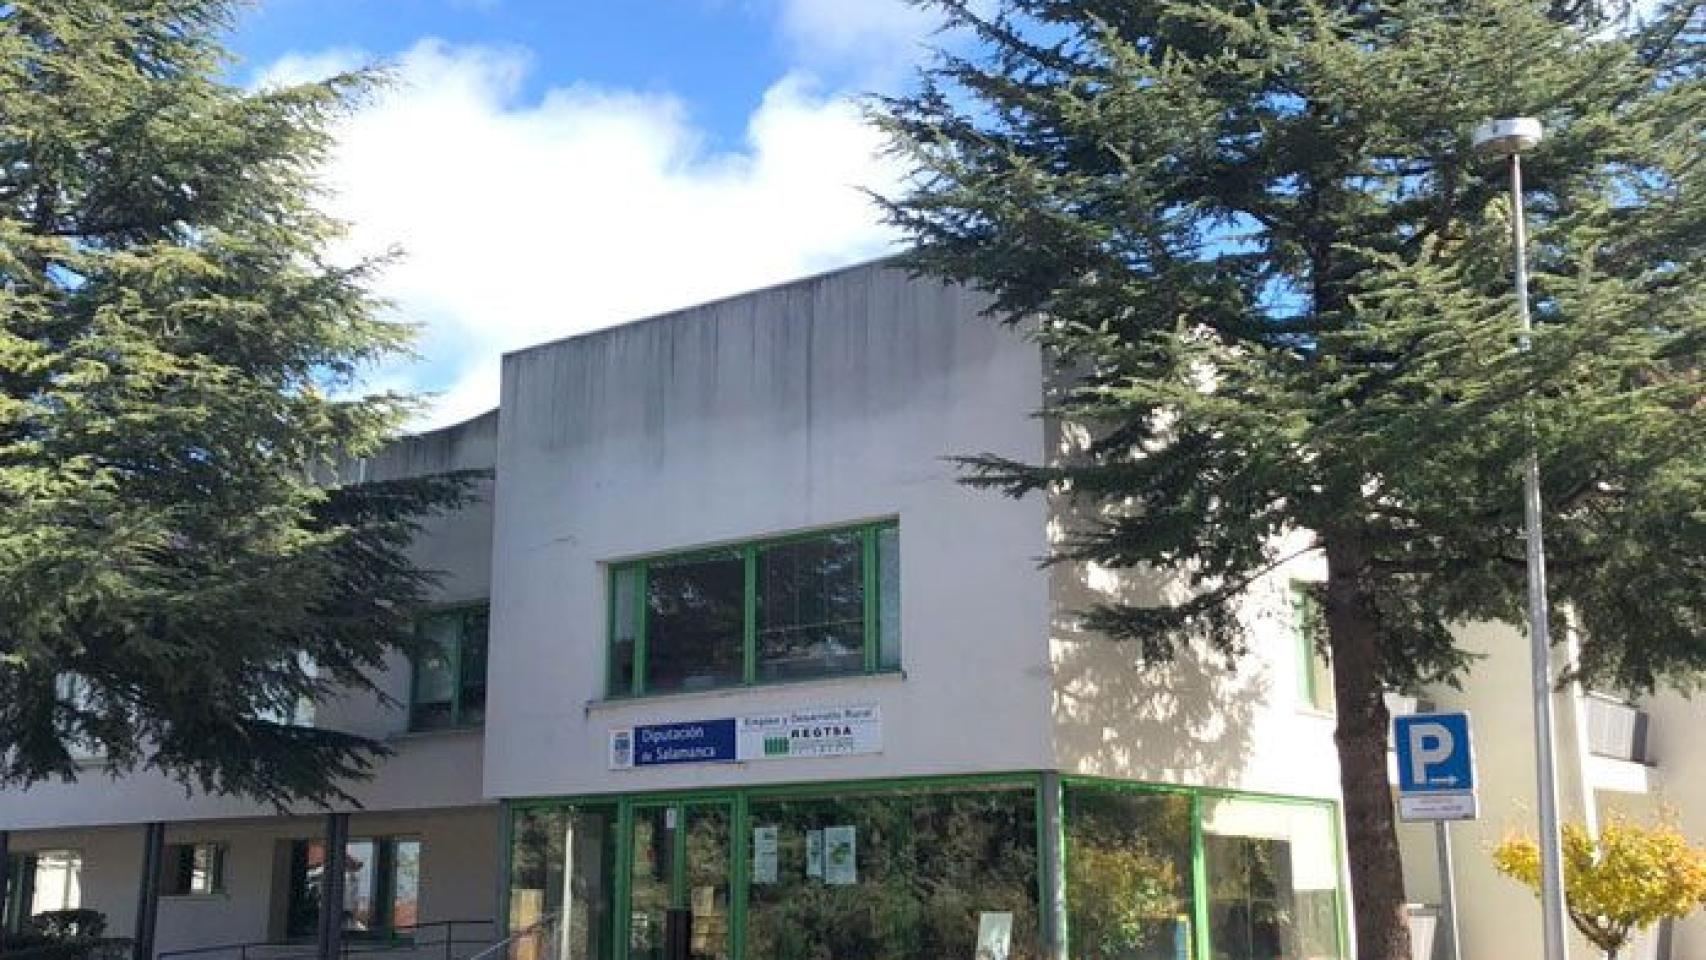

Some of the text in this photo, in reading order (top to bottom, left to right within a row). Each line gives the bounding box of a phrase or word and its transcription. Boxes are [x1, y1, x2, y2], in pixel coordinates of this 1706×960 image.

[641, 726, 704, 744] Diputación
[656, 746, 716, 760] Salamanca
[1409, 724, 1454, 785] P
